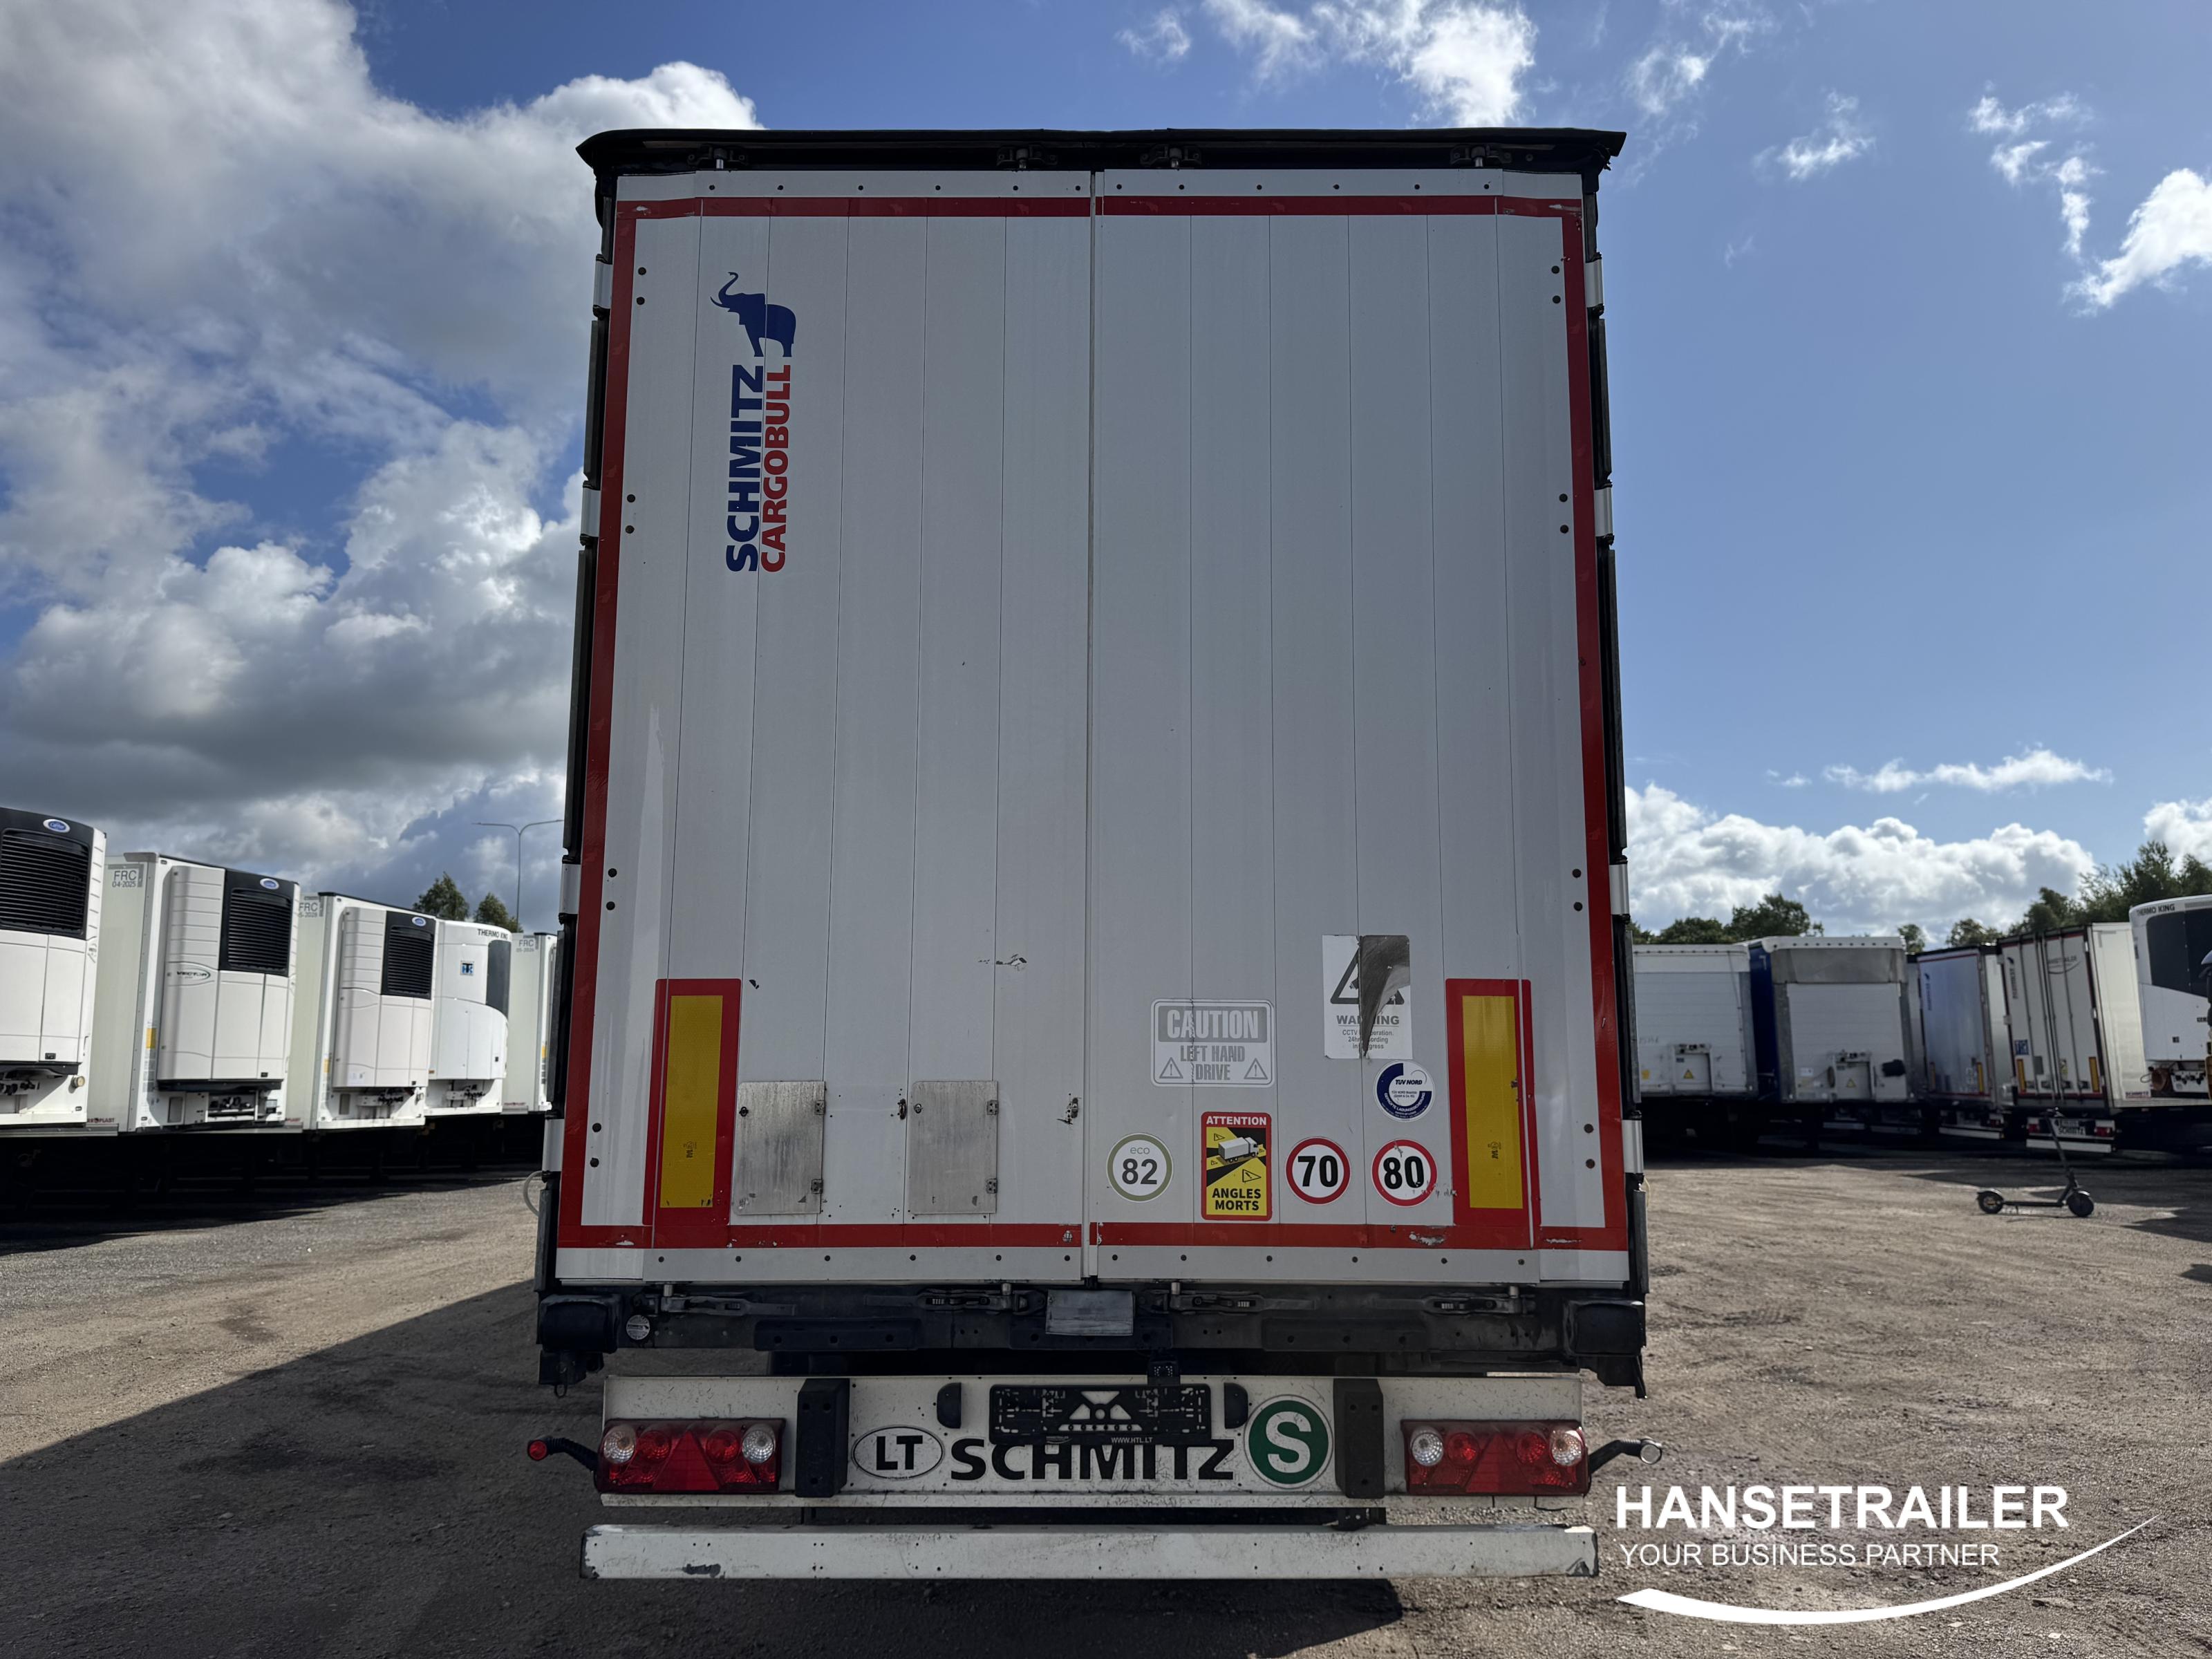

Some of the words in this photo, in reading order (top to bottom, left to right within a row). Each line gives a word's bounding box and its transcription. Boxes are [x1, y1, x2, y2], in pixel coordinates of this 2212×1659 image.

[726, 364, 764, 572] SCHMITZ
[761, 364, 791, 572] CARGOBULL
[114, 870, 137, 881] FRC
[299, 902, 318, 912] FRC
[2158, 903, 2175, 912] KING
[477, 928, 500, 938] THERMO
[1167, 1009, 1259, 1038] CAUTION
[1336, 1015, 1400, 1024] WAING
[1180, 1045, 1208, 1062] LEFT
[1211, 1045, 1245, 1062] HAND
[1195, 1064, 1230, 1080] DRIVE
[1206, 1116, 1266, 1125] ATTENTION
[1122, 1158, 1158, 1185] 82
[1297, 1155, 1338, 1188] 70
[1383, 1156, 1425, 1190] 80
[1212, 1188, 1262, 1199] ANGLES
[1215, 1199, 1259, 1211] MORTS
[1267, 1411, 1312, 1474] S
[877, 1435, 923, 1470] LT
[950, 1438, 1235, 1481] SCHMITZ
